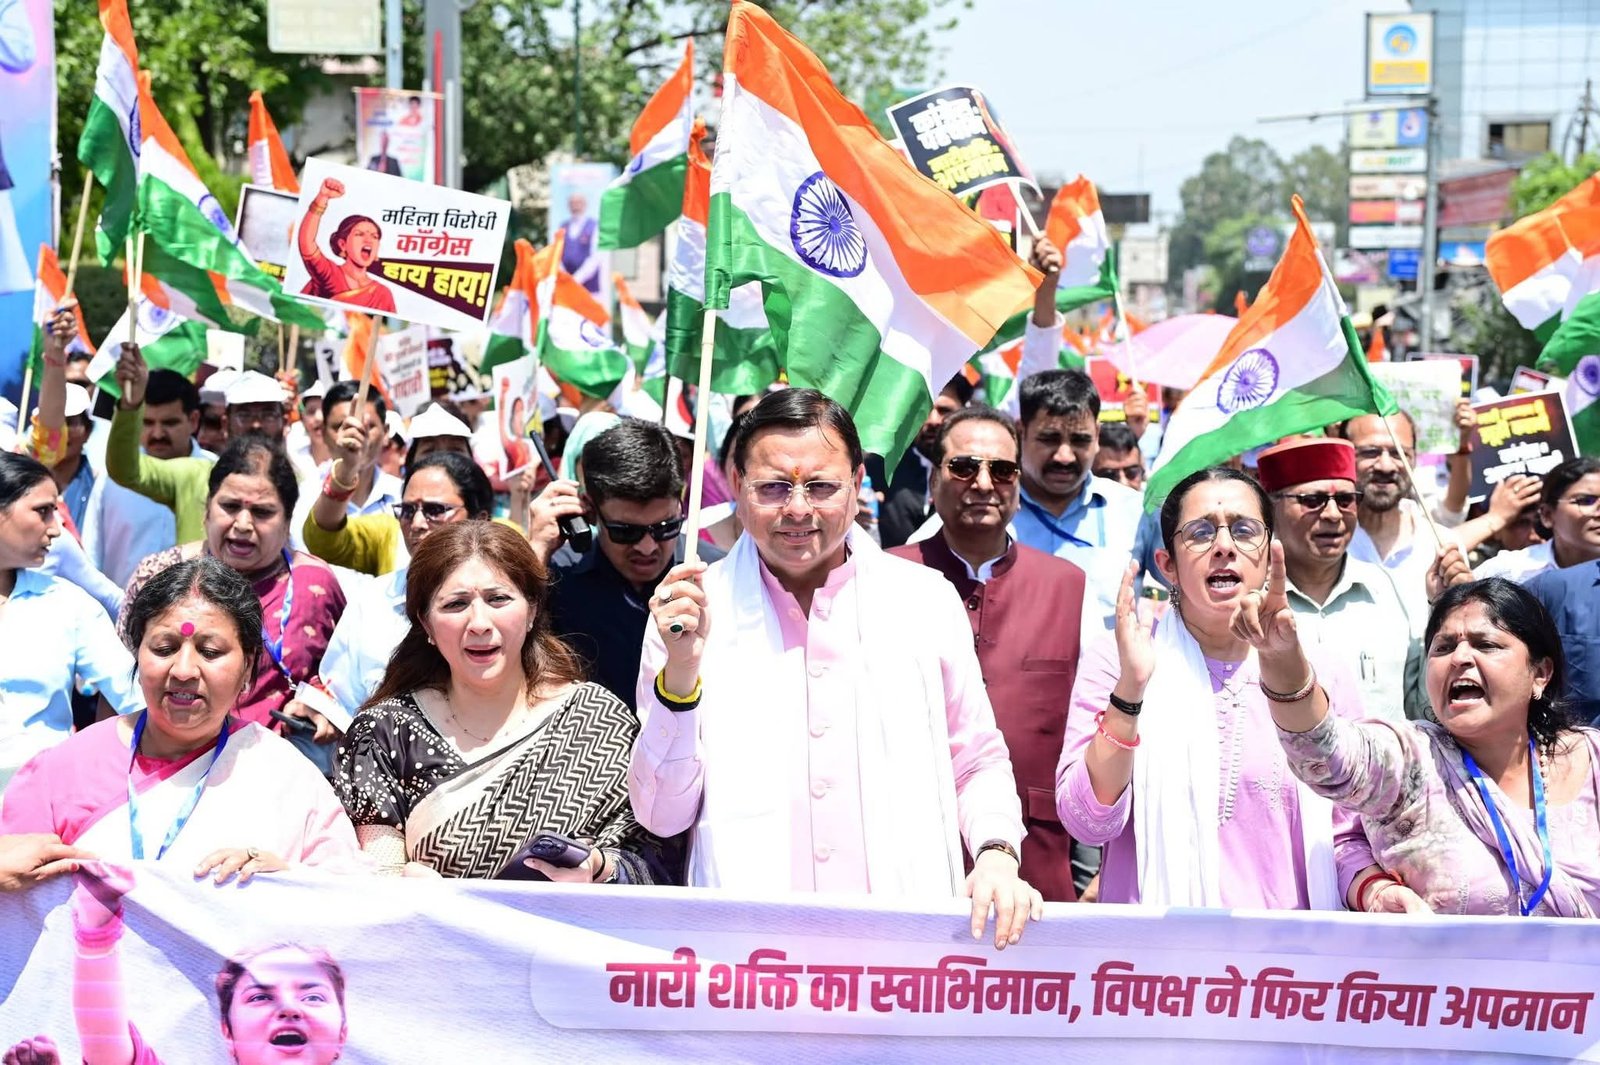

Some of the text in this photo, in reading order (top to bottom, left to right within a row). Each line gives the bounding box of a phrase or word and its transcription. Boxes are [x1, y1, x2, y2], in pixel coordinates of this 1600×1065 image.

[381, 206, 497, 231] महिला विरोधी
[381, 261, 491, 308] हाय हाय!
[606, 946, 1595, 1034] नारी शक्ति का स्वाभिमान, विपक्ष ने फिर किया अपमान
